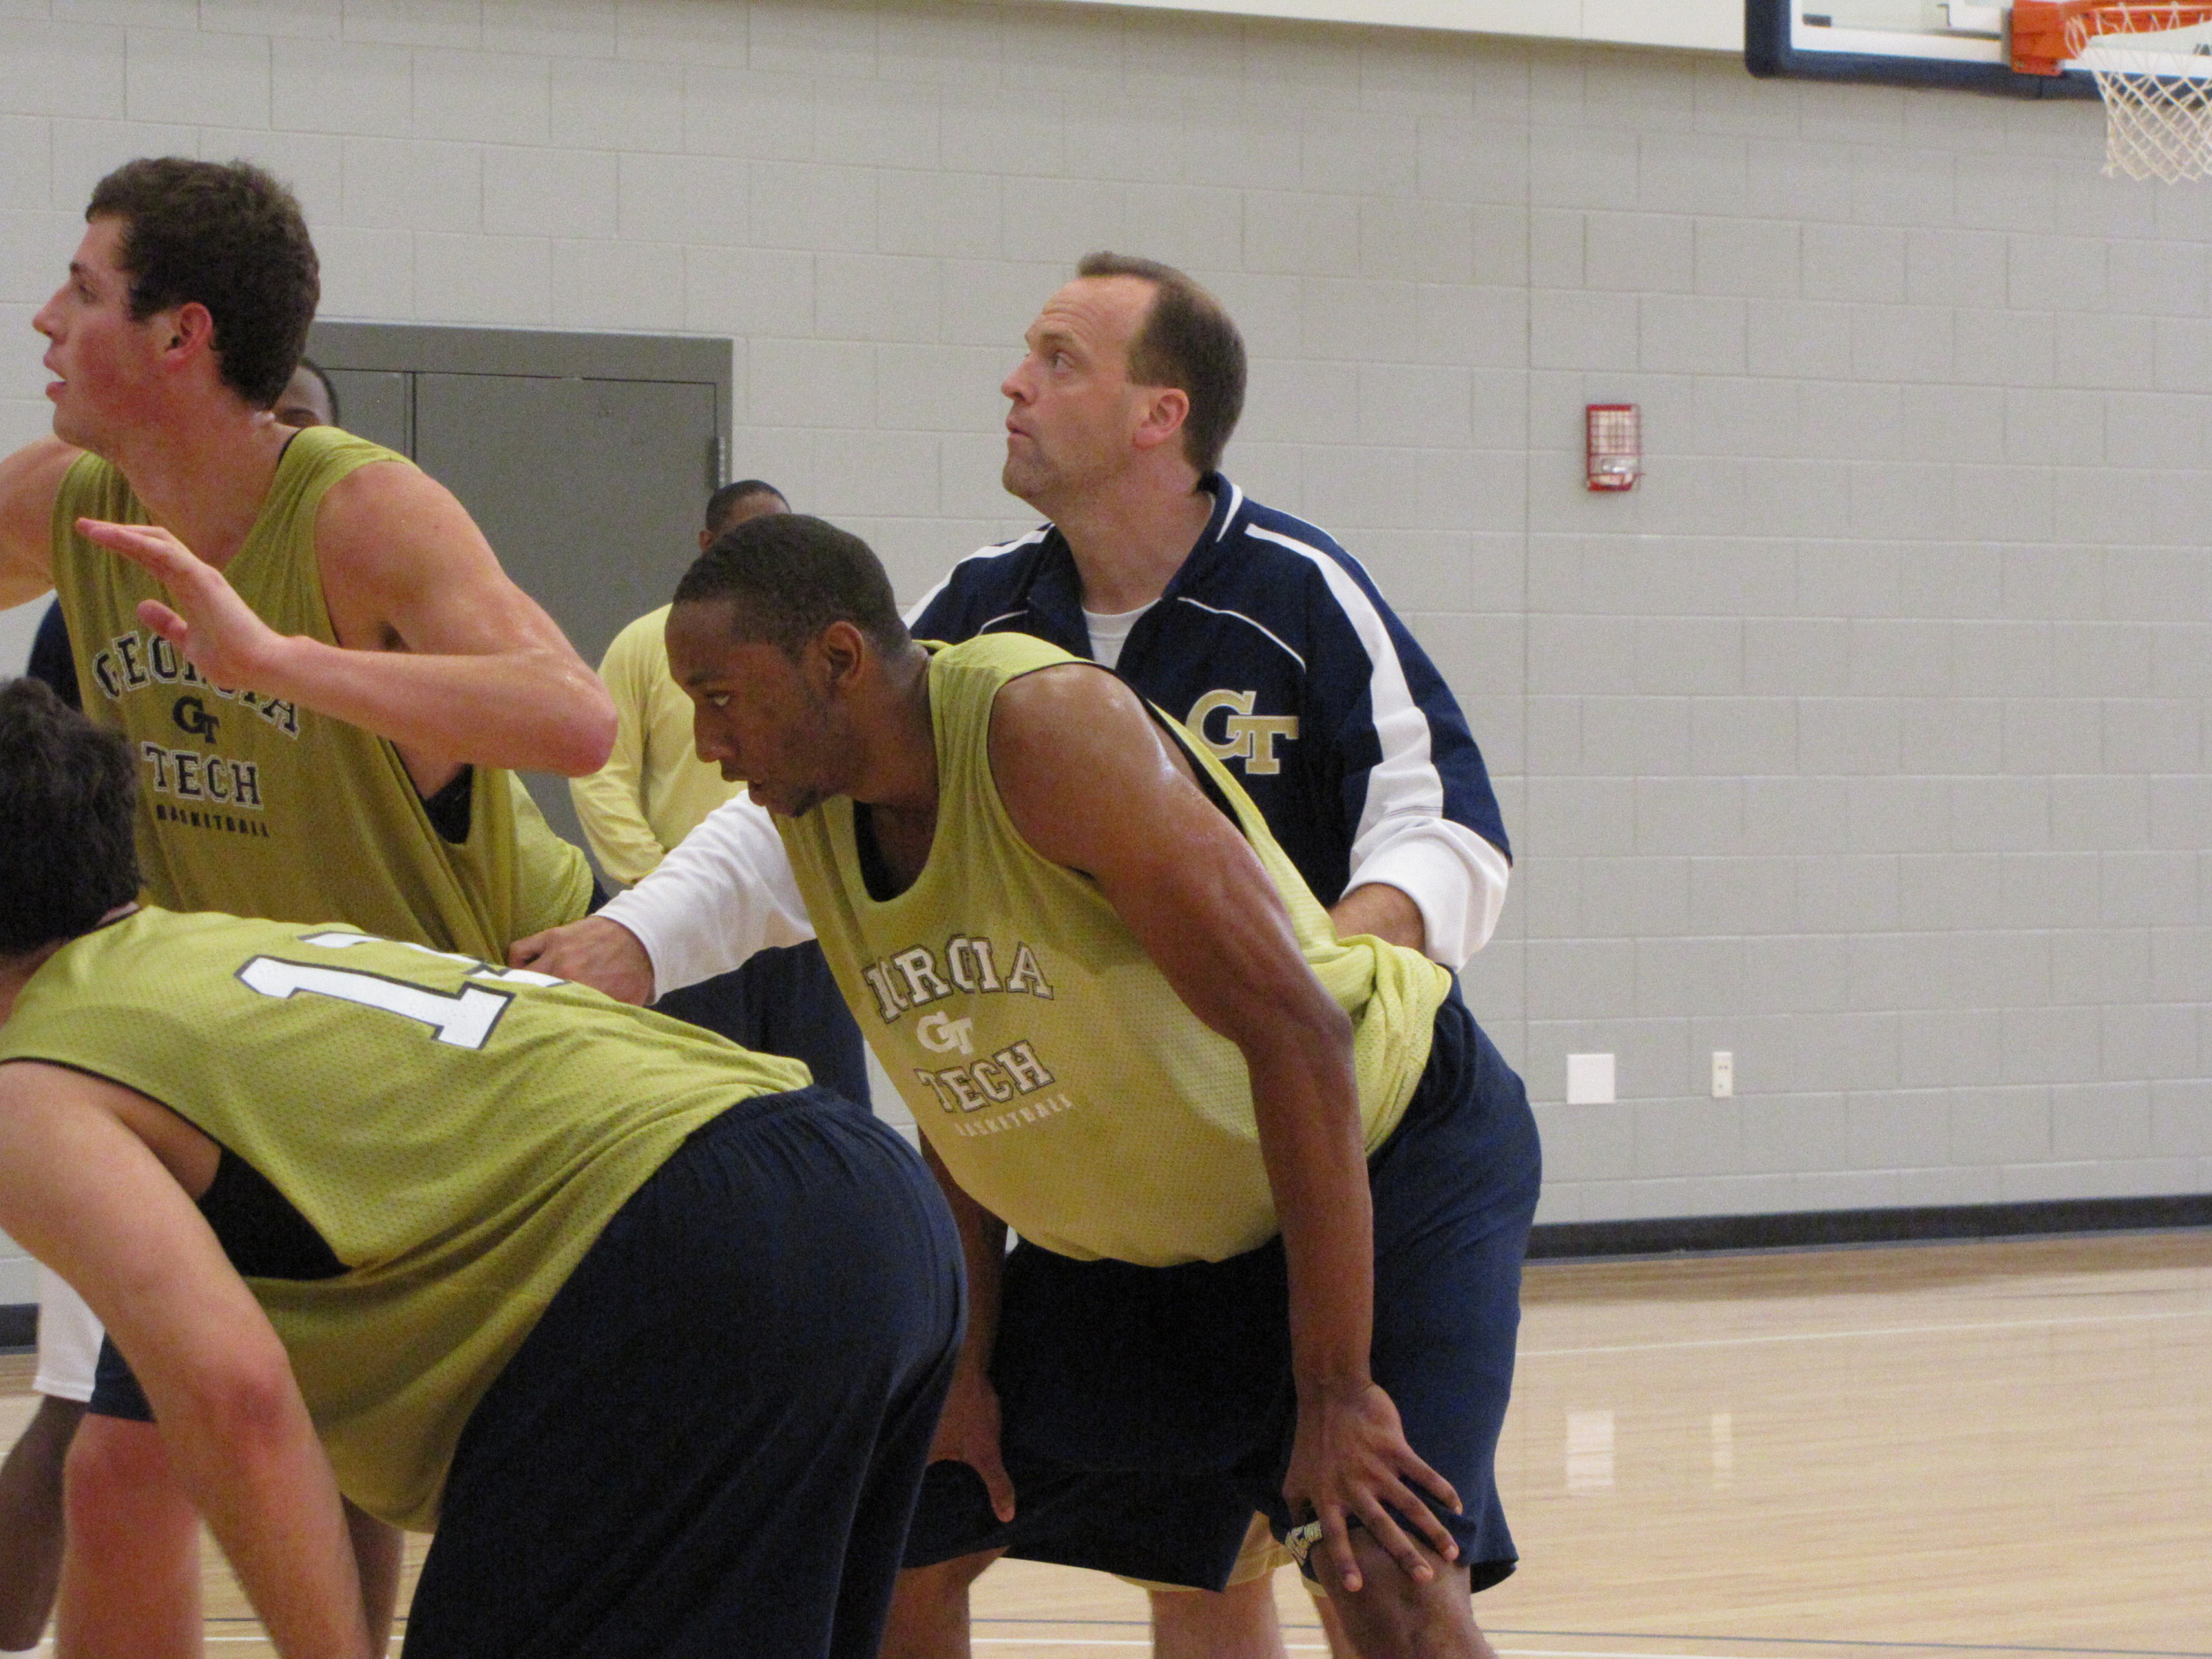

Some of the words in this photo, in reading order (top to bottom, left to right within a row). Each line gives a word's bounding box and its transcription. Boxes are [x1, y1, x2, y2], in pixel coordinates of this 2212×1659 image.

[173, 695, 220, 744] GT
[1186, 688, 1299, 774] GT
[142, 741, 264, 810] TECH
[917, 1010, 973, 1056] GT
[913, 1039, 1056, 1113] TECH
